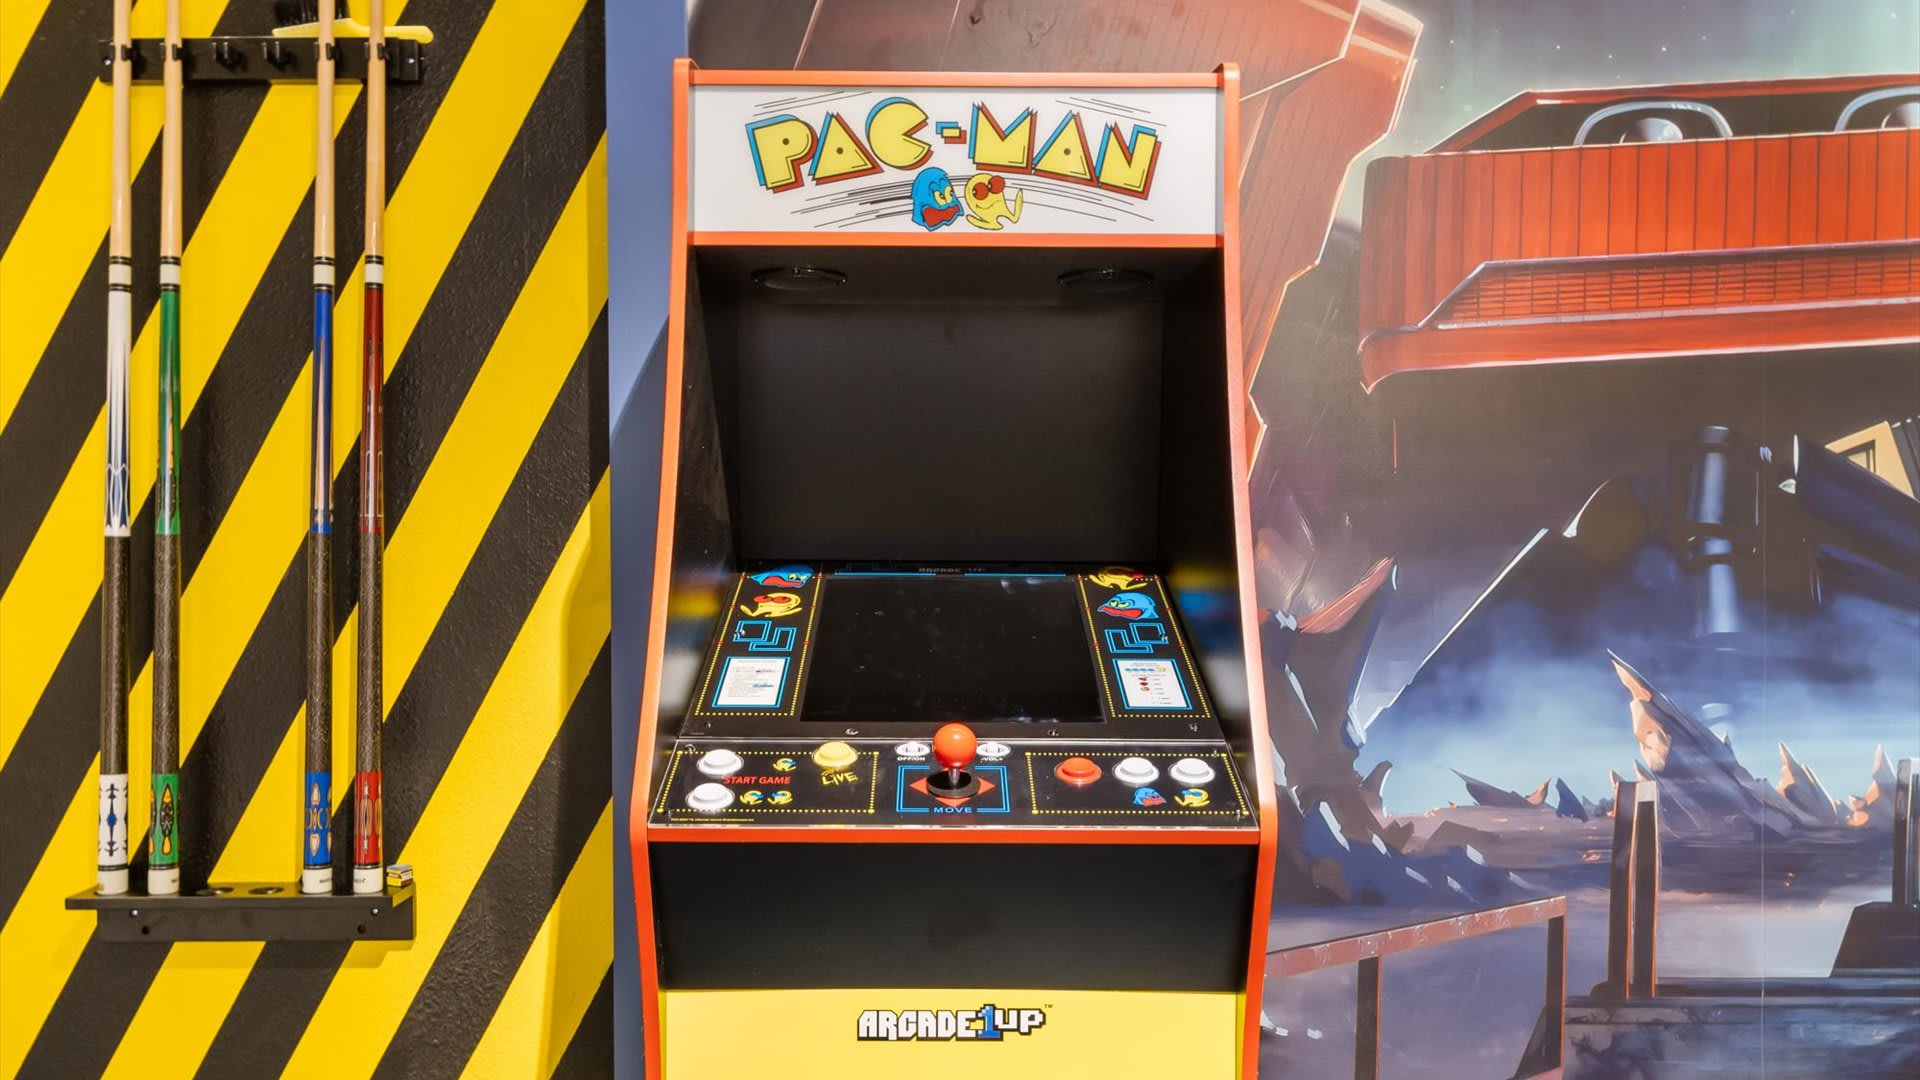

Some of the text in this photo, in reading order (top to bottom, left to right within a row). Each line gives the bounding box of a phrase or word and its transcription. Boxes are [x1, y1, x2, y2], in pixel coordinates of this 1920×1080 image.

[745, 96, 1162, 201] PAC-MAN
[723, 776, 791, 785] START GAME
